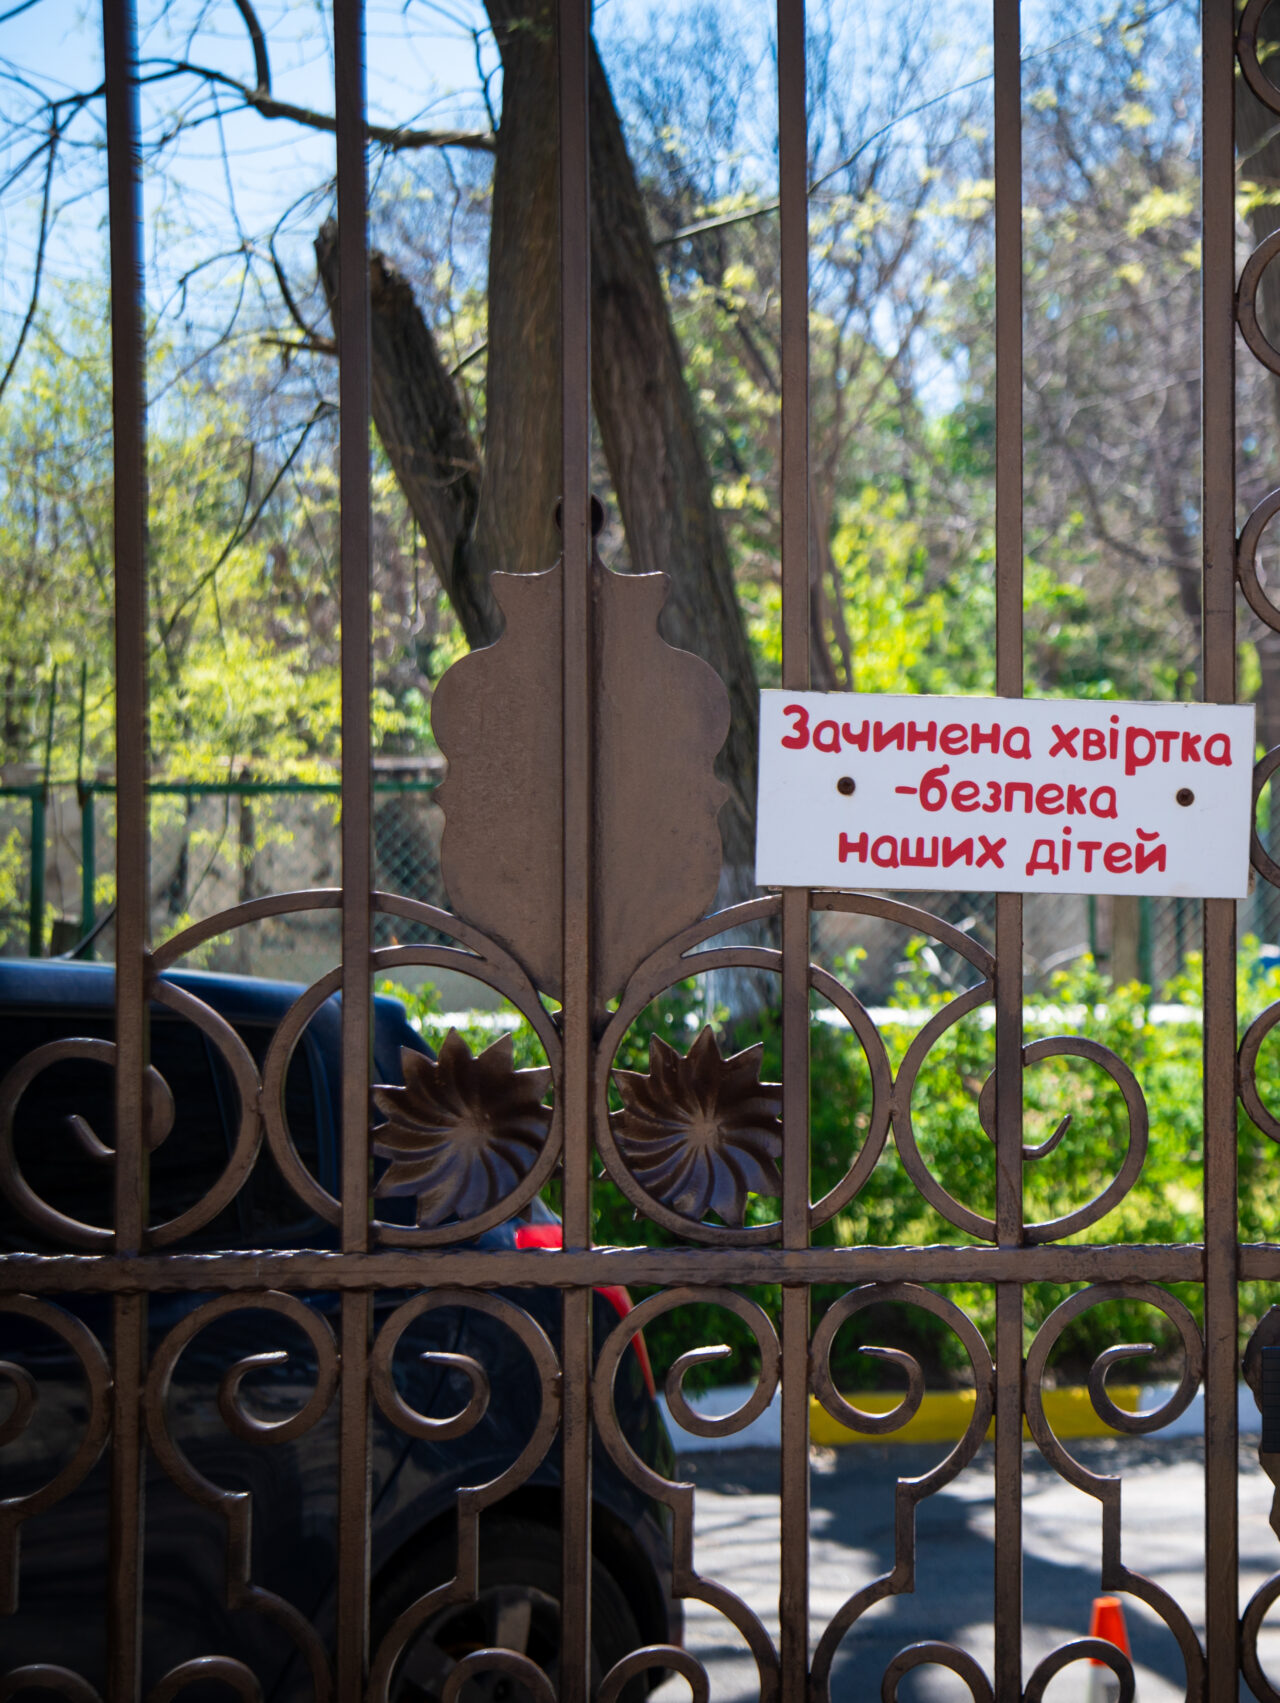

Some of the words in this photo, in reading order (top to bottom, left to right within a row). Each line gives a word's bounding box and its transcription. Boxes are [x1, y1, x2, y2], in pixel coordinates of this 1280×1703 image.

[780, 703, 1032, 761] Зачинена
[1048, 714, 1233, 777] хвіртка
[894, 763, 1119, 820] -безпека
[838, 831, 1007, 869] наших
[1025, 825, 1167, 877] дітей
